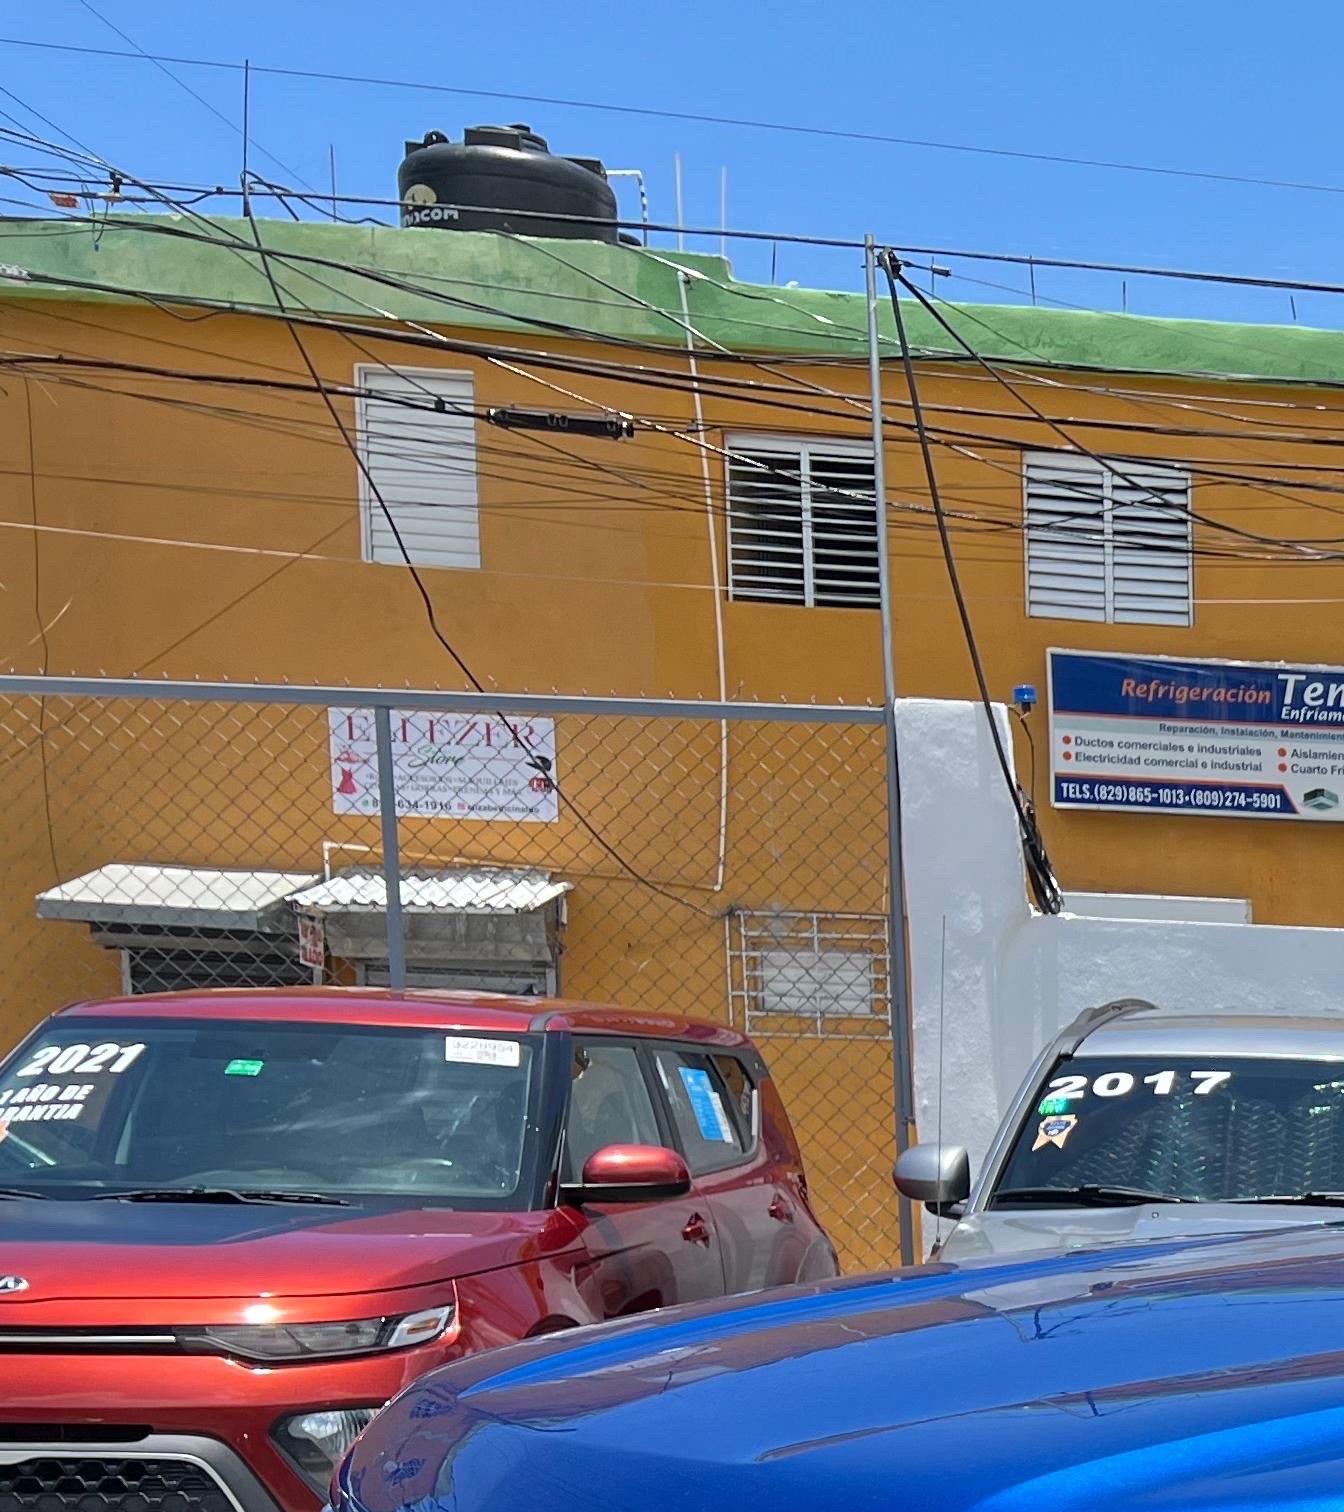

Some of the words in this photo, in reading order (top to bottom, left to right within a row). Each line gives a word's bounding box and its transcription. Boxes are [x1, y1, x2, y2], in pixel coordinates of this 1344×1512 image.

[1121, 678, 1271, 704] Refrigeración
[346, 715, 537, 749] EIEZER
[1159, 723, 1218, 736] Reparación,
[1221, 726, 1277, 739] Instalación,
[1075, 737, 1114, 749] Ductos
[1118, 739, 1185, 753] comerciales
[1188, 745, 1194, 753] e
[1197, 744, 1262, 756] industriales
[1075, 752, 1141, 766] Electricidad
[1144, 756, 1198, 769] comercial
[1201, 762, 1208, 770] e
[1211, 759, 1263, 772] industrial
[1291, 763, 1328, 775] Cuarto
[17, 1043, 146, 1077] 2021
[10, 1083, 60, 1104] AÑO
[58, 1084, 95, 1101] DE
[1045, 1070, 1231, 1100] 2017
